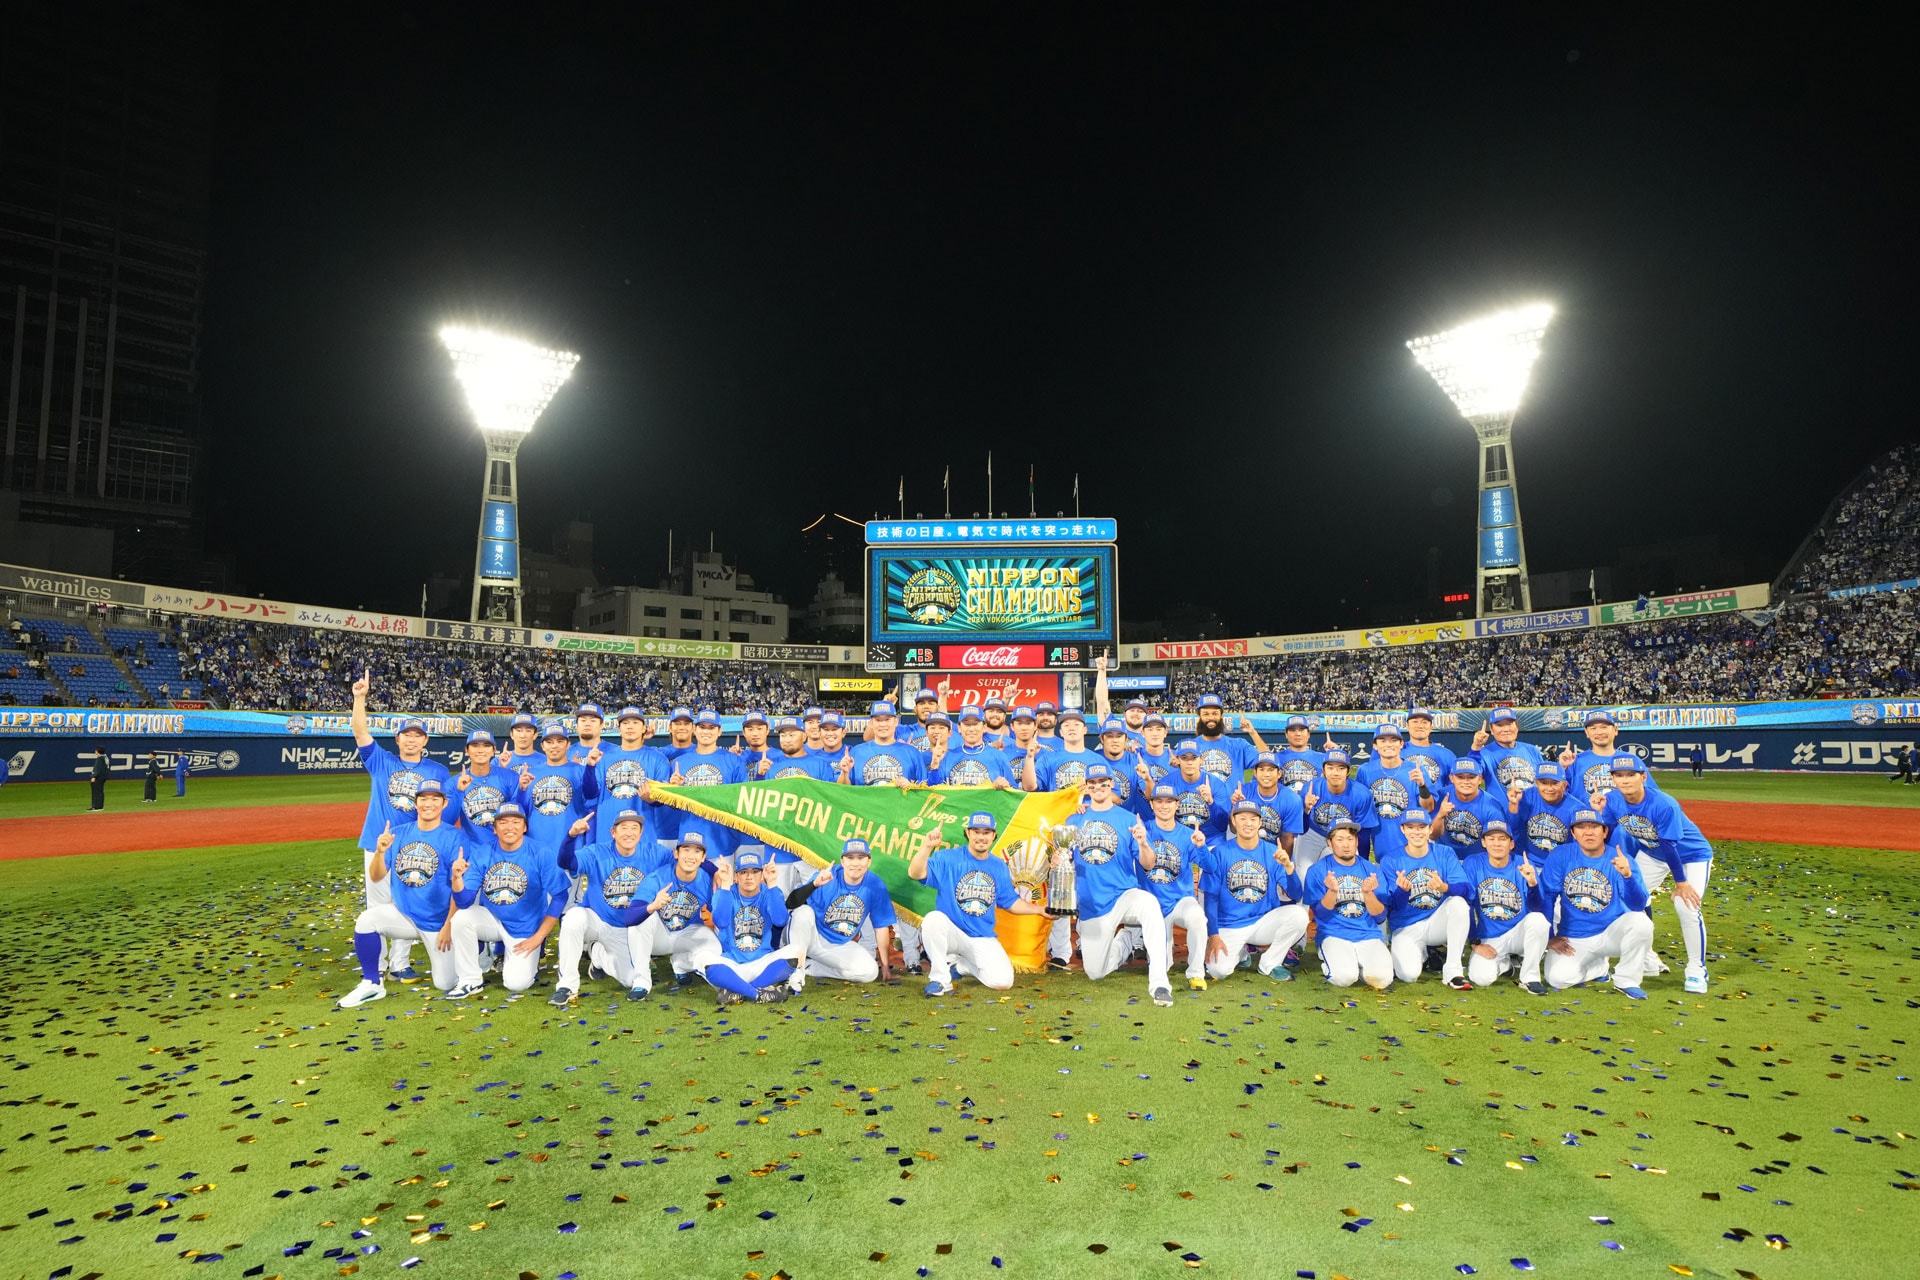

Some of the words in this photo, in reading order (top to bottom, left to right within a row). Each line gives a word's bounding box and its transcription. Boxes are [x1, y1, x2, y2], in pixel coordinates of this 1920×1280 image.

[1494, 531, 1504, 556] 挑戦を
[697, 570, 723, 580] YMCA
[966, 568, 1081, 586] NIPPON
[20, 575, 112, 600] wamiles
[153, 594, 193, 605] ありあけ
[194, 597, 287, 617] ハーバー
[907, 592, 956, 608] CHAMPIONS
[966, 587, 1082, 615] CHAMPIONS
[1502, 611, 1583, 630] 神奈川工科大学
[657, 643, 749, 656] 住友ベークライト
[744, 646, 793, 659] 昭和大学
[962, 646, 1022, 667] Coca-Cola
[1157, 642, 1229, 658] NITTAN
[977, 678, 1013, 687] SUPER
[1567, 710, 1646, 722] NPON
[1649, 708, 1738, 726] CHAMPIONS
[1884, 703, 1920, 717] NI
[0, 712, 86, 727] IPPON
[87, 713, 185, 734] CHAMPIONS
[312, 716, 387, 729] NIPON
[1651, 743, 1760, 764] ヨコレイ
[1821, 742, 1915, 766] コロワ
[297, 760, 363, 770] 日本発条株式会社
[736, 785, 833, 830] NIPPON
[928, 810, 958, 824] NPB
